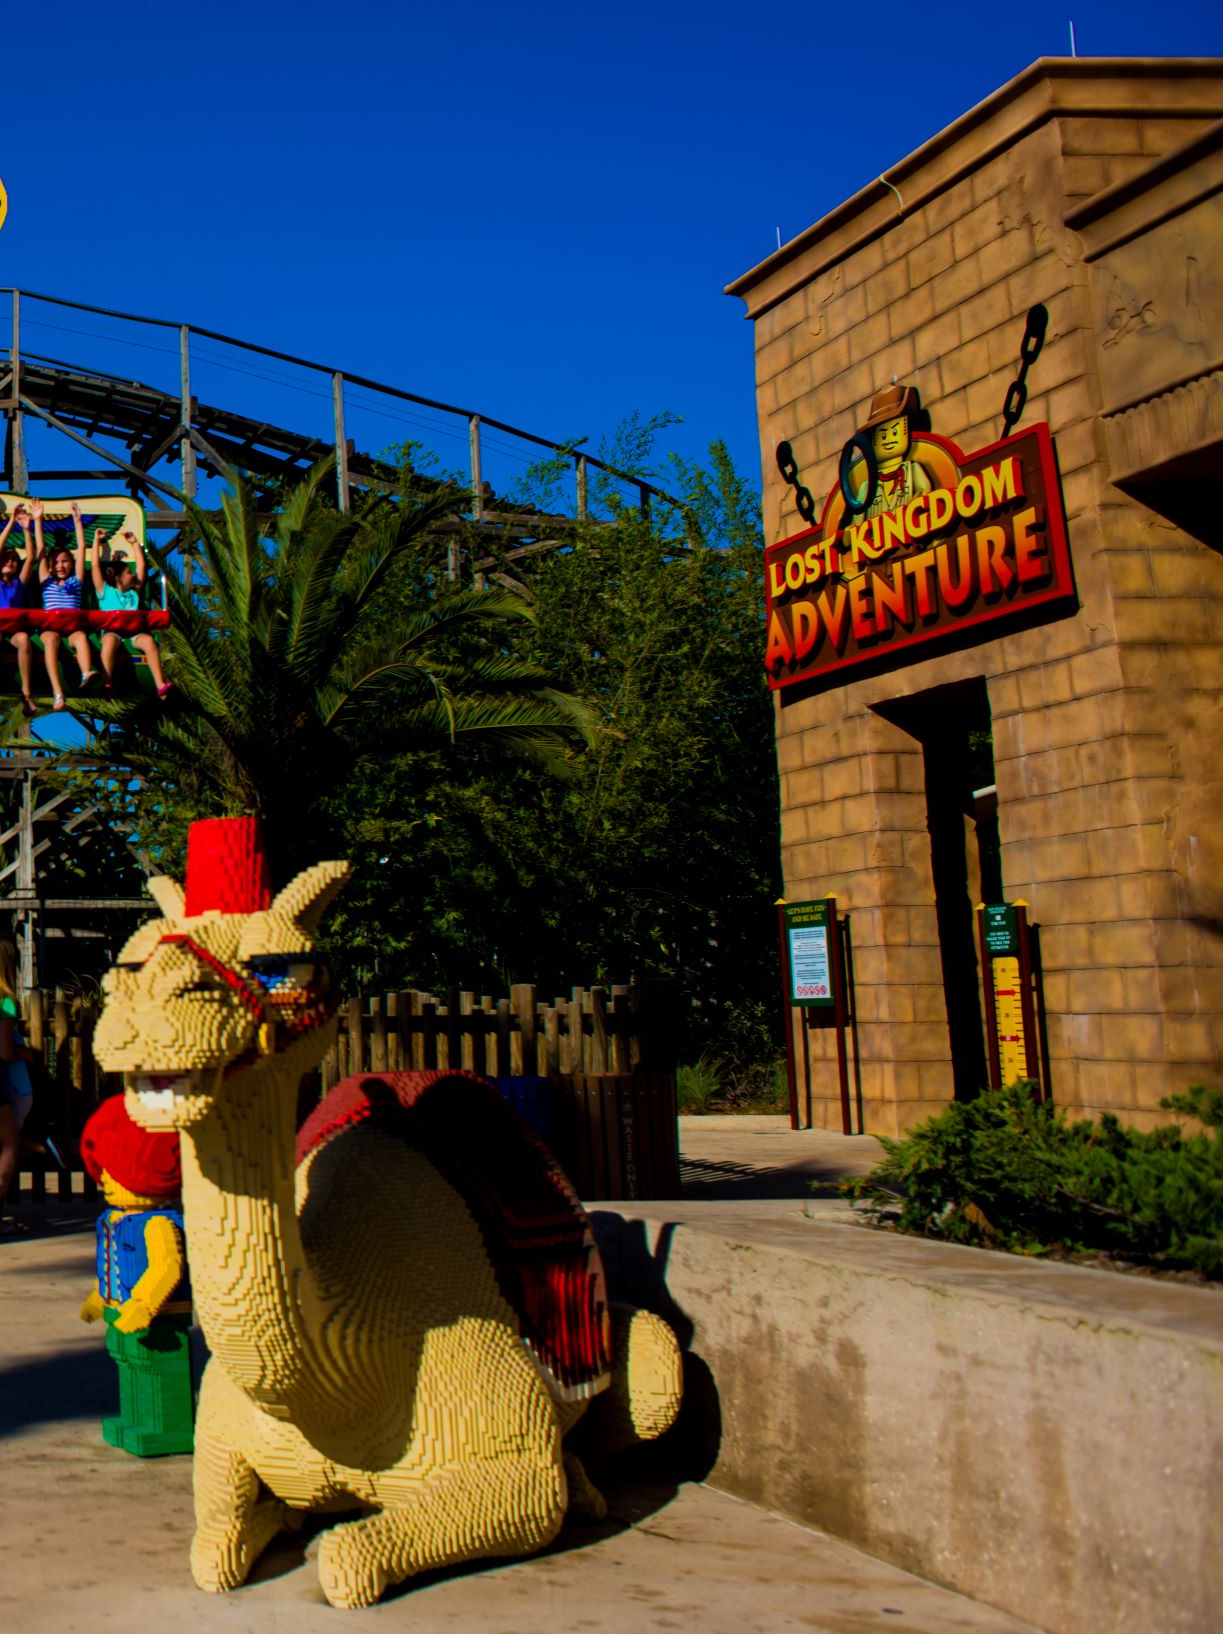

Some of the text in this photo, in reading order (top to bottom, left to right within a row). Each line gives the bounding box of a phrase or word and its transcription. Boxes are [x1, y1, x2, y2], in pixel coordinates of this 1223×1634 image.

[764, 506, 1045, 672] ADVENTURE
[768, 456, 1018, 598] LOST KINGDOM
[622, 1117, 637, 1199] WASTE ONLY
